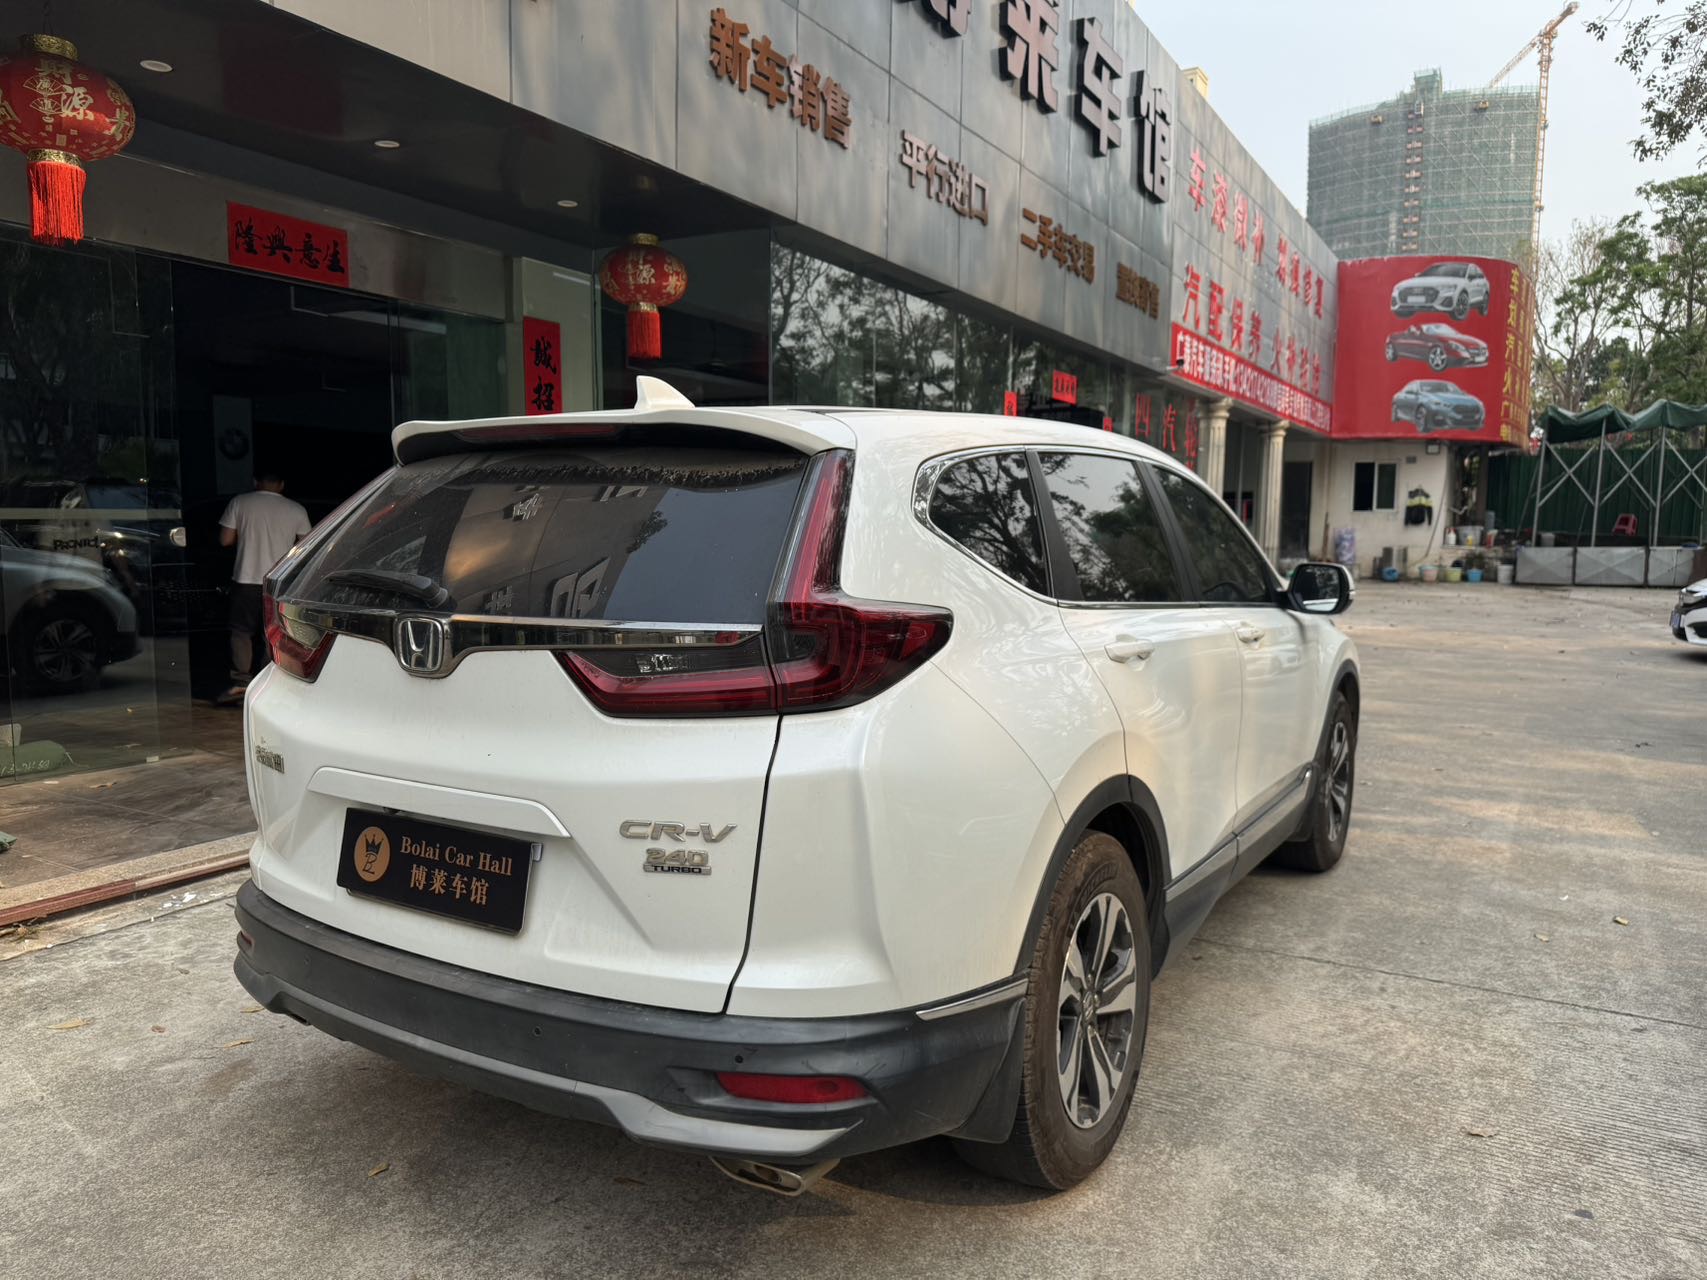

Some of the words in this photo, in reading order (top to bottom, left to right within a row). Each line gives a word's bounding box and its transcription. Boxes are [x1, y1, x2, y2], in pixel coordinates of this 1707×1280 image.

[709, 7, 852, 149] 新车销售
[900, 130, 989, 226] 平行进口
[1020, 207, 1095, 285] 二手车交易
[619, 819, 738, 843] CR-V
[400, 836, 440, 861] Bolai
[444, 846, 474, 867] Car
[478, 852, 513, 876] Hall
[645, 847, 709, 867] 240
[652, 864, 702, 874] TURBO
[409, 864, 490, 905] 博莱车馆
